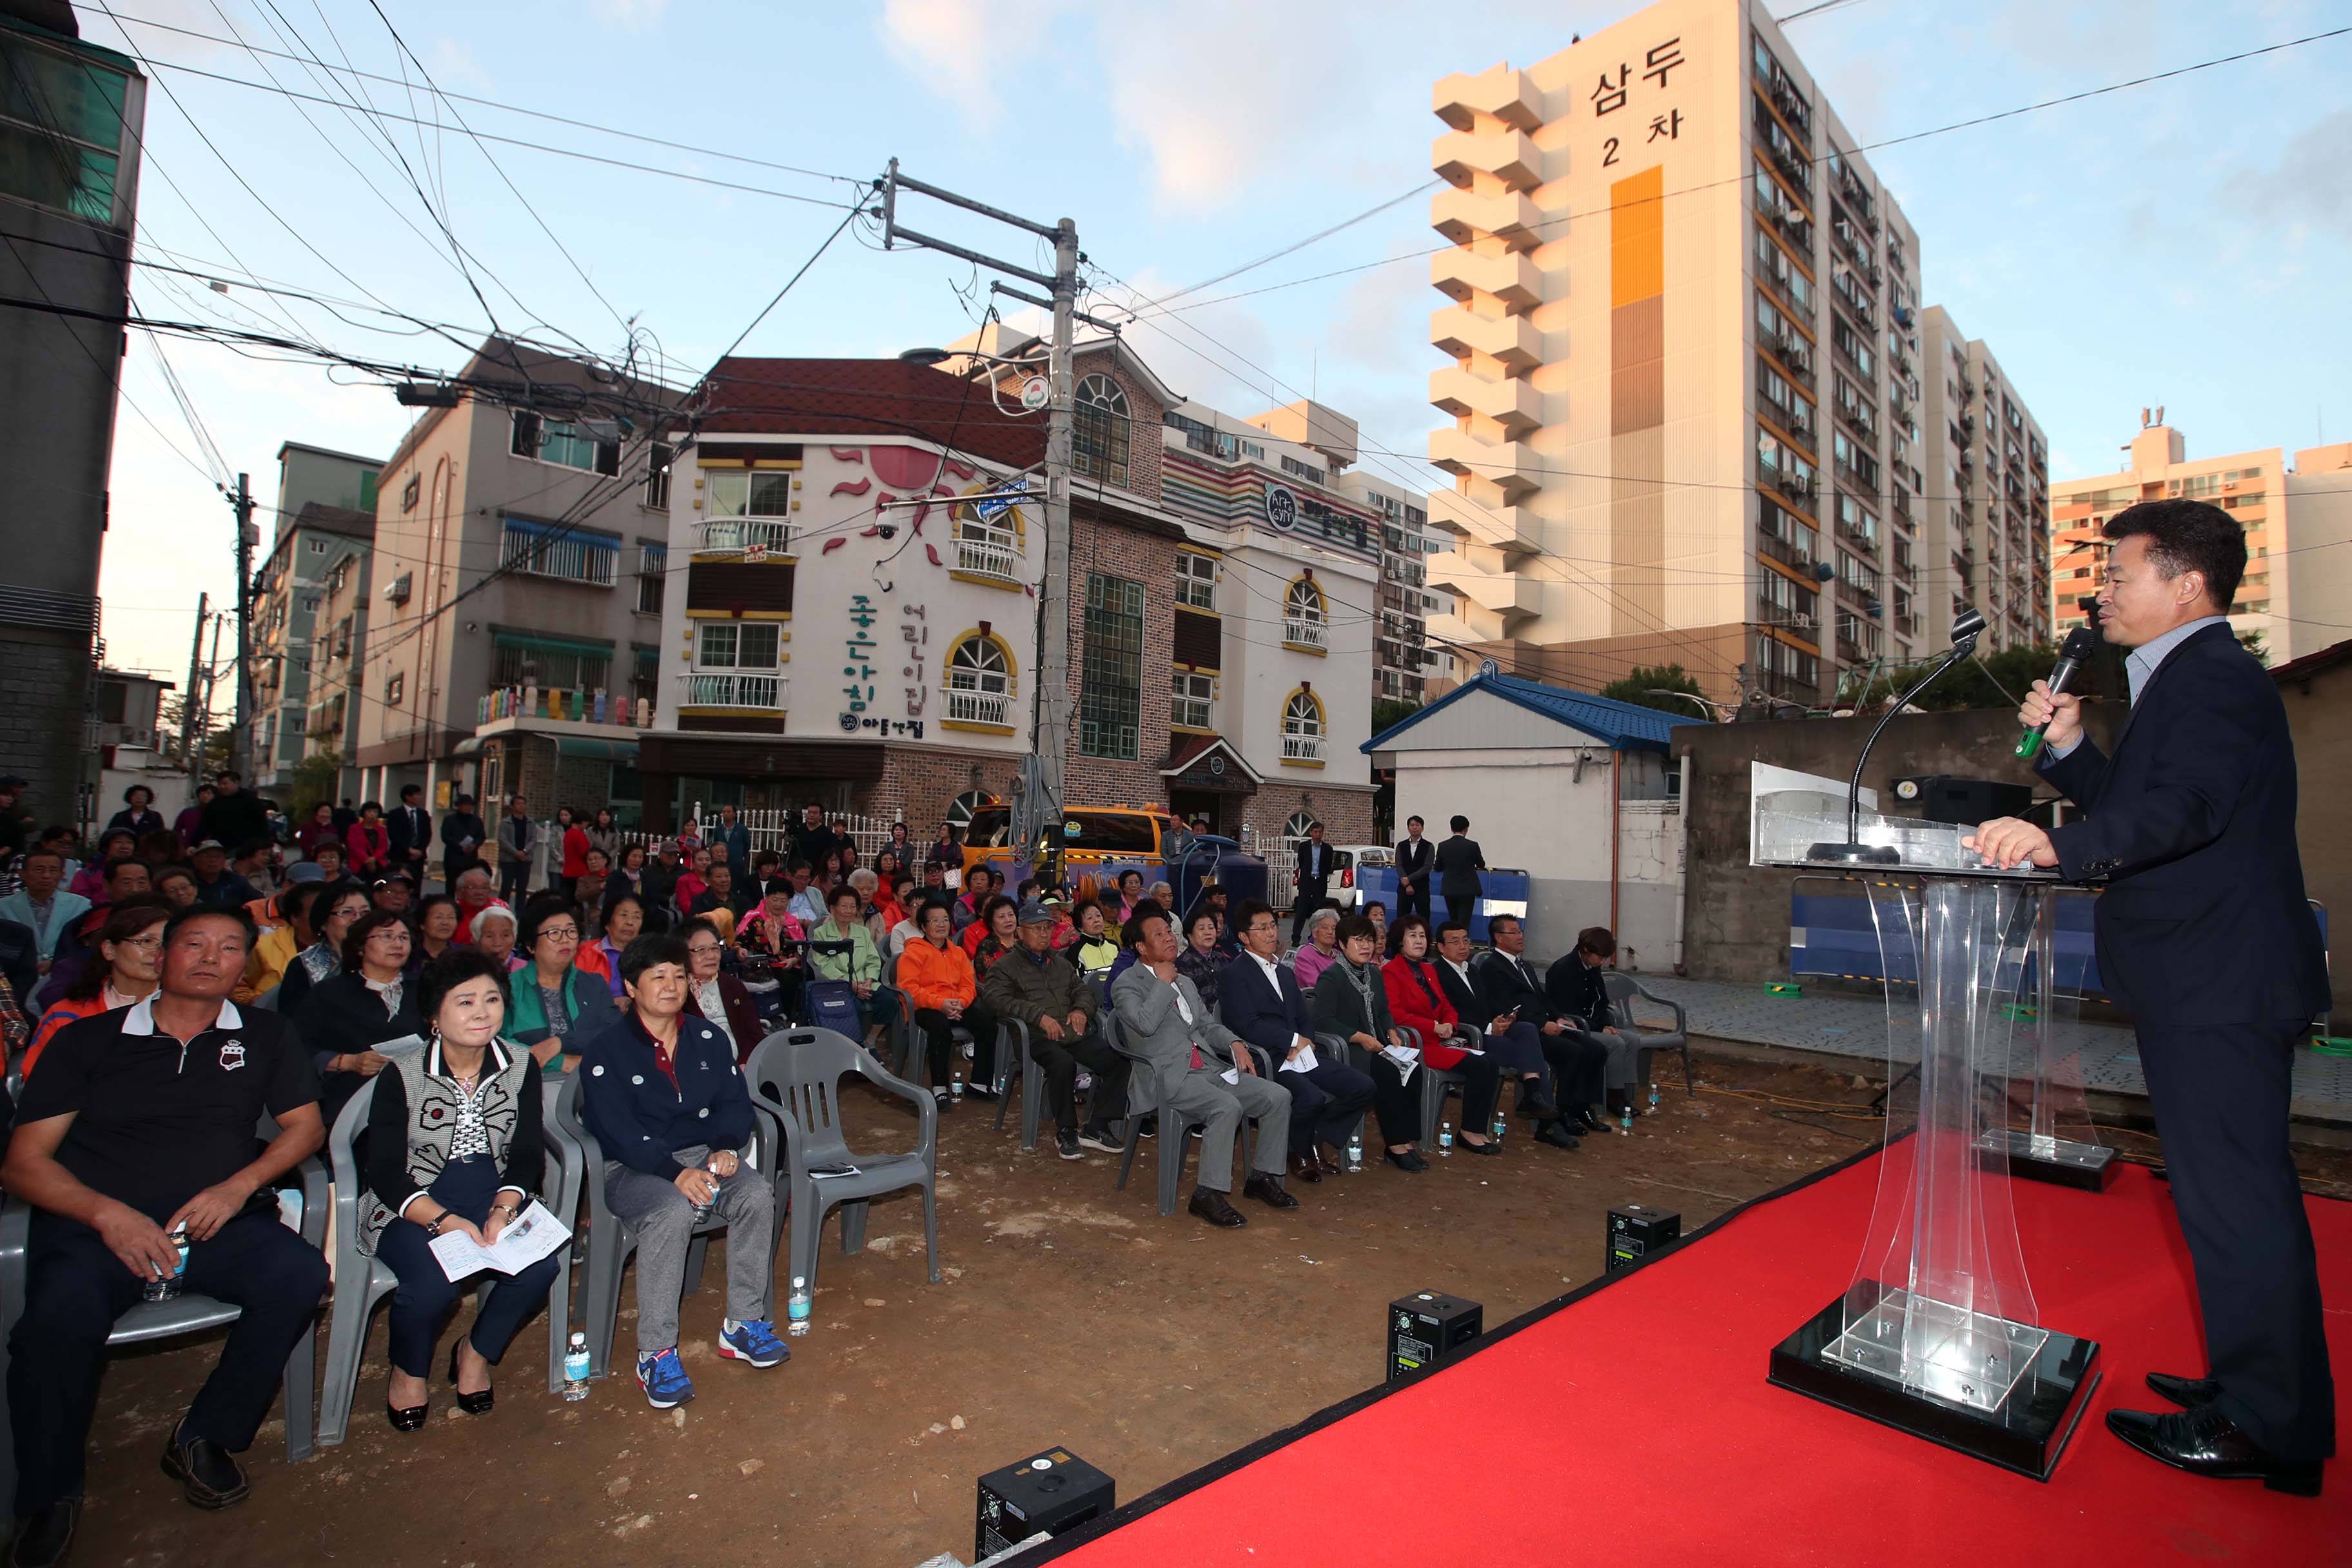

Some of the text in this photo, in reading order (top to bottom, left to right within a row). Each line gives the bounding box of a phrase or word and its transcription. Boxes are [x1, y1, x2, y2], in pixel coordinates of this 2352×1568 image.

[1590, 36, 1685, 117] 삼두
[1271, 493, 1291, 509] Art
[901, 604, 927, 716] 어린이집
